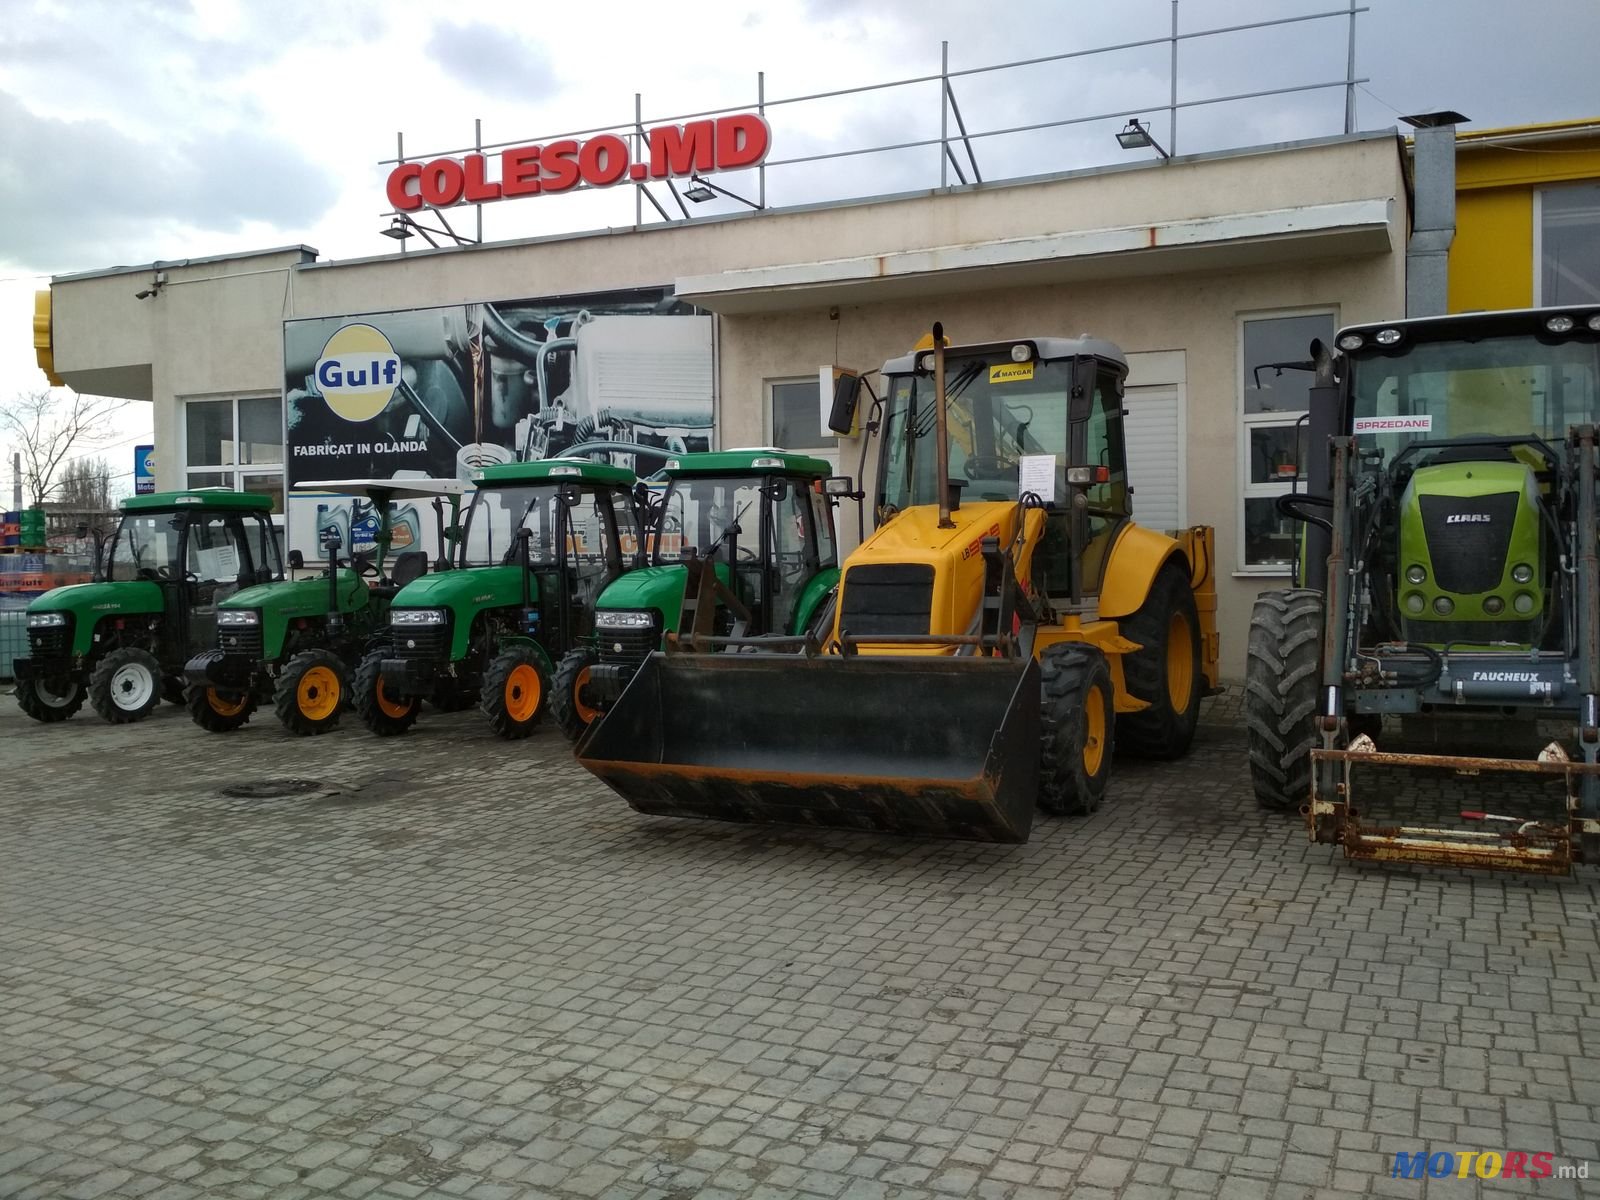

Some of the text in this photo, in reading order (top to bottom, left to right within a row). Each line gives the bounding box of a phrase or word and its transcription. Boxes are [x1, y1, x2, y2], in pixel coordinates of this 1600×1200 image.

[386, 113, 772, 214] COLESO.MD
[318, 359, 397, 388] Gulf
[1001, 369, 1032, 377] MAYGAR
[1356, 419, 1430, 430] SPRZEDANE
[293, 441, 428, 456] FABRICAT IN OLANDA
[1446, 514, 1491, 524] CLAAS
[1472, 672, 1540, 682] FAUCHEUX
